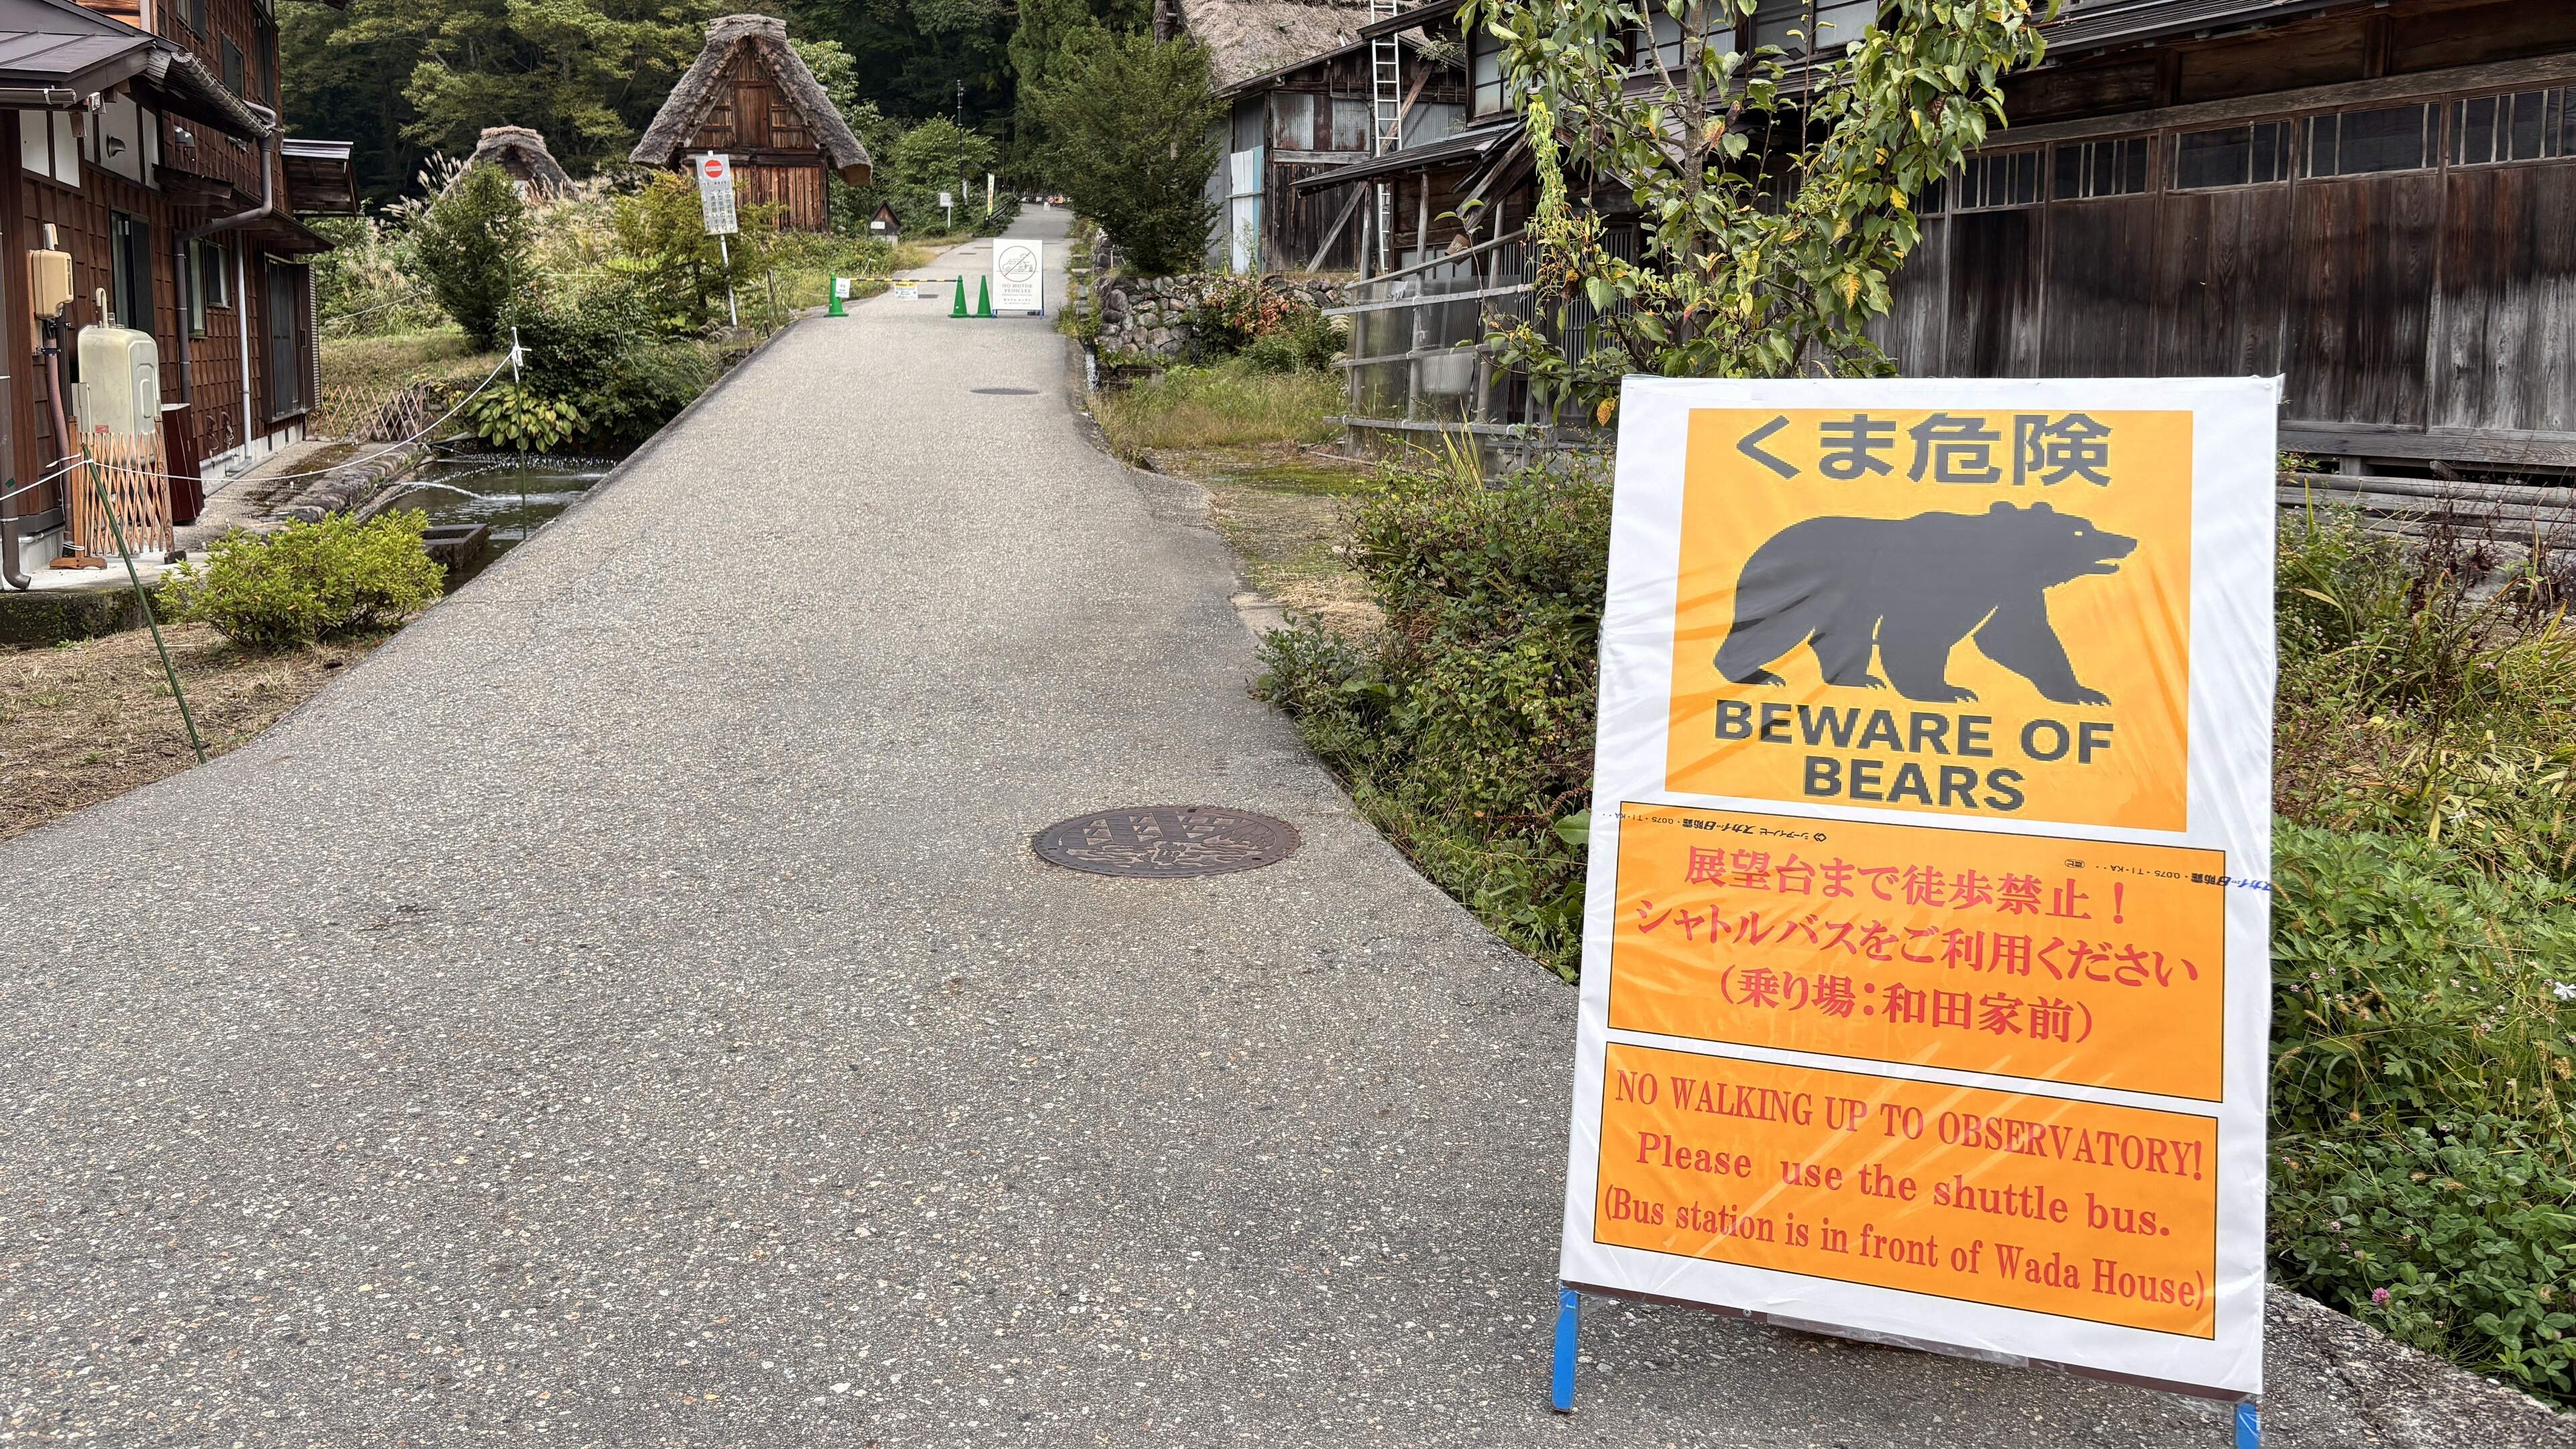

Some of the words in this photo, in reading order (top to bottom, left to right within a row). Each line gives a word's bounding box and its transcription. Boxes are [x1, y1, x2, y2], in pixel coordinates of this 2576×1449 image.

[1738, 414, 2110, 485] くま危険
[1716, 700, 1992, 757] BEWARE
[2022, 720, 2113, 762] OF
[1805, 757, 2024, 811] BEARS
[1686, 847, 2123, 924] 展望台まで徒歩禁止！
[1639, 901, 2198, 987] シャトルバスをご利用ください
[1721, 966, 2092, 1043] （乗り場：和田家前）
[1614, 1069, 1658, 1106] NO
[1671, 1077, 1812, 1125] WALKING
[1825, 1097, 1866, 1132] UP
[1880, 1104, 1923, 1139] TO
[1939, 1112, 2201, 1181] OBSERVATORY!
[1637, 1132, 1751, 1177] Please
[1782, 1161, 1841, 1190] use
[1859, 1164, 1916, 1201] the
[1934, 1175, 2068, 1223] shuttle
[2085, 1193, 2169, 1236] bus.
[1605, 1185, 1663, 1225] (Bus
[1676, 1201, 1774, 1242] station
[1786, 1213, 1809, 1247] is
[1821, 1218, 1848, 1253] in
[1860, 1224, 1938, 1267] front
[1951, 1240, 1983, 1274] of
[1994, 1244, 2080, 1289] Wada
[2092, 1258, 2204, 1311] House)
